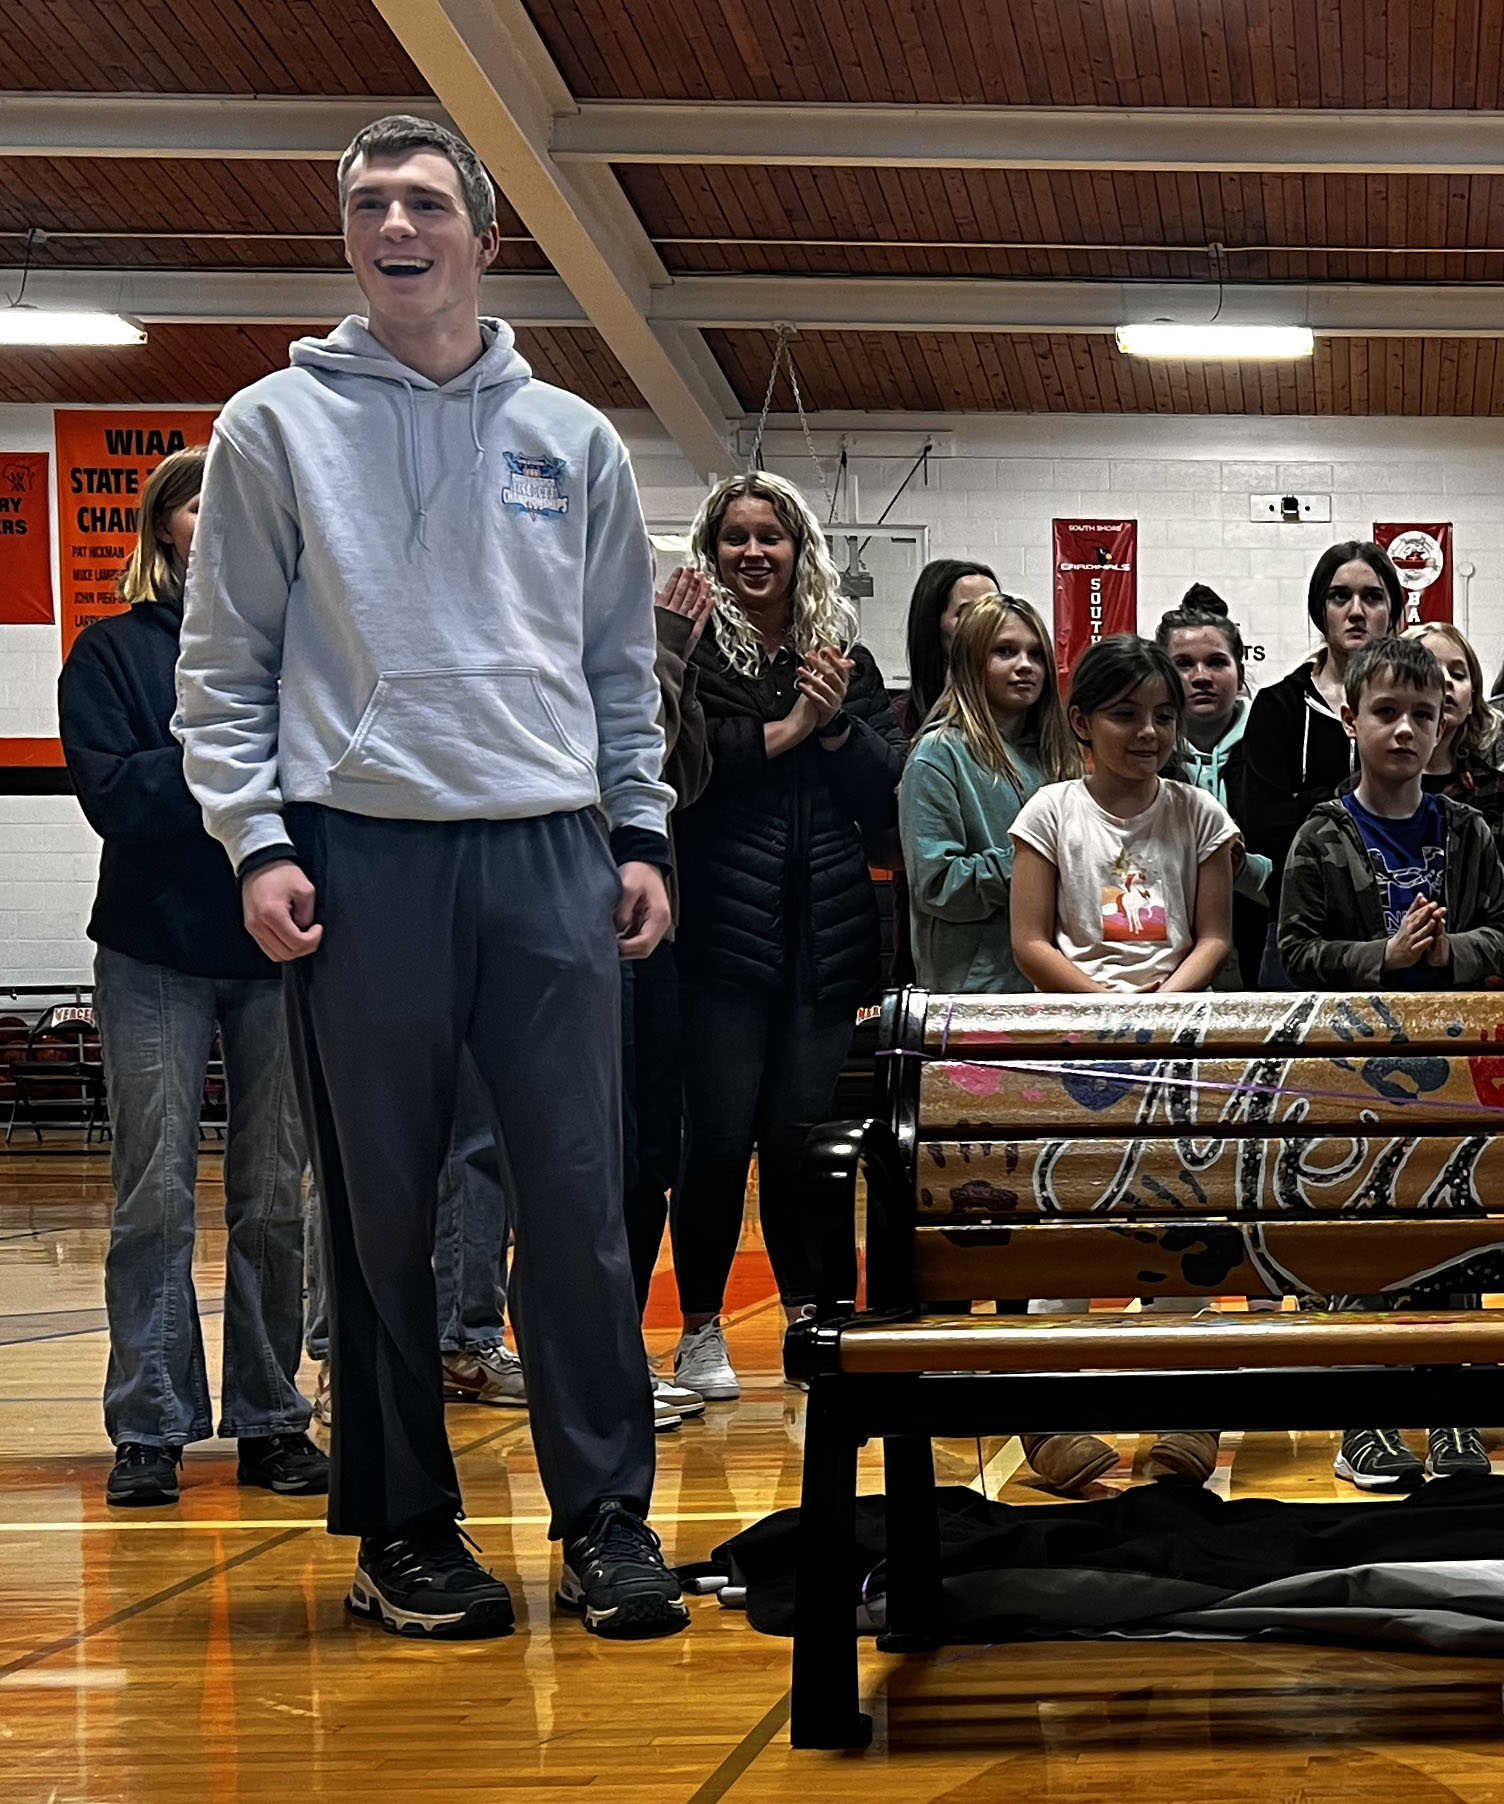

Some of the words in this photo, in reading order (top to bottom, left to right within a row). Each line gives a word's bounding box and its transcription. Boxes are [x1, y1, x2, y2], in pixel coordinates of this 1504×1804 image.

[104, 429, 187, 456] WIAA
[70, 467, 139, 494] STATE
[0, 519, 28, 535] RS
[1068, 524, 1095, 533] SOUTH
[1096, 524, 1122, 532] SHORE
[71, 545, 87, 558] PAT
[1060, 562, 1131, 572] CARDINALS
